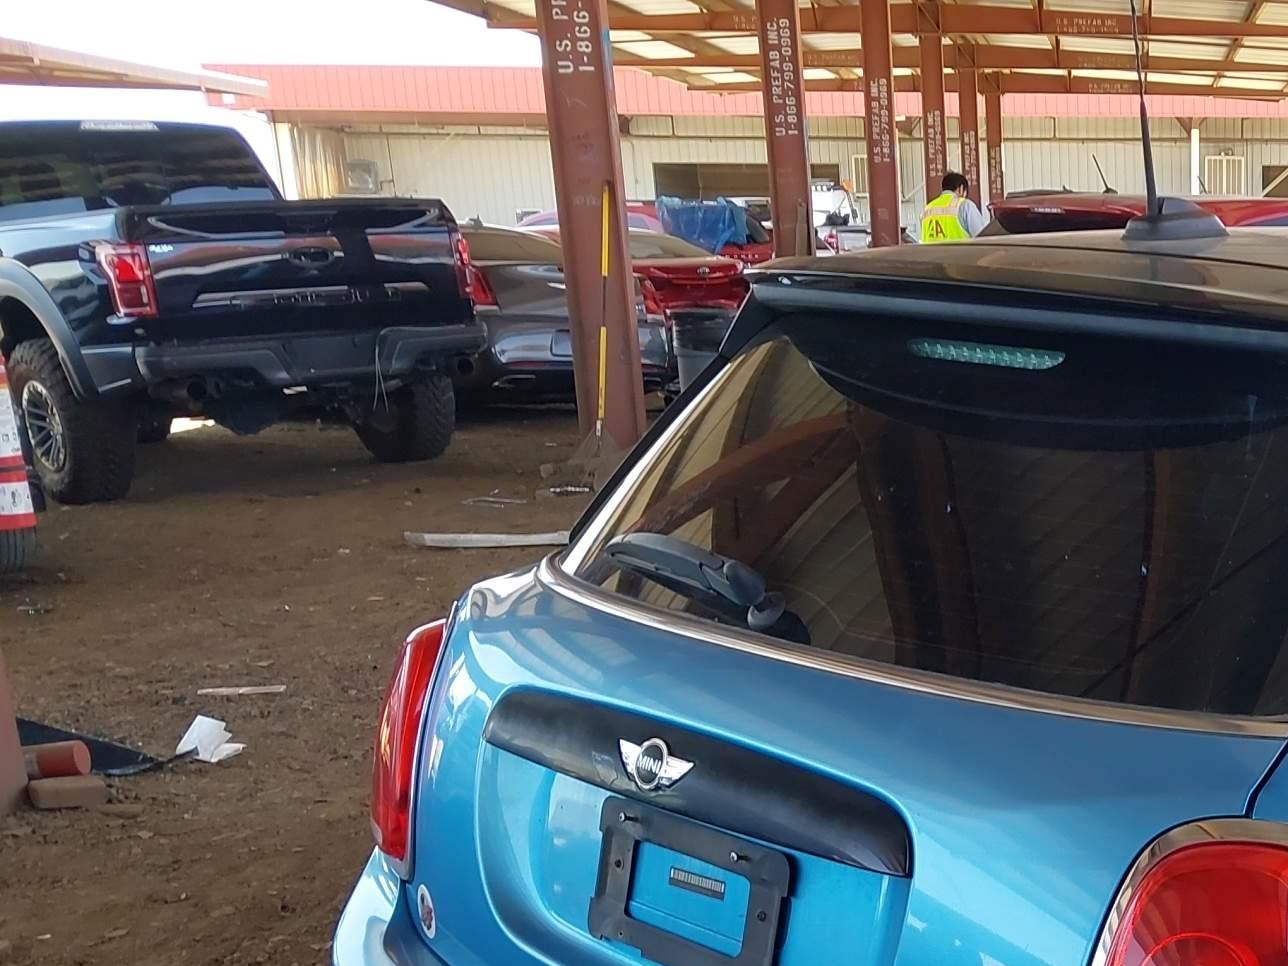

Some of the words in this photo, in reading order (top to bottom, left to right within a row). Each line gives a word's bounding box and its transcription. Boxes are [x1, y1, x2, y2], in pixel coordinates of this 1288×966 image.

[767, 17, 779, 44] INC.
[555, 33, 574, 74] U.S.
[769, 50, 783, 104] PREFAB
[779, 18, 799, 135] 1-866-799-0969
[775, 111, 786, 136] U.S.
[871, 101, 881, 140] PREFAB
[637, 755, 662, 774] MINI
